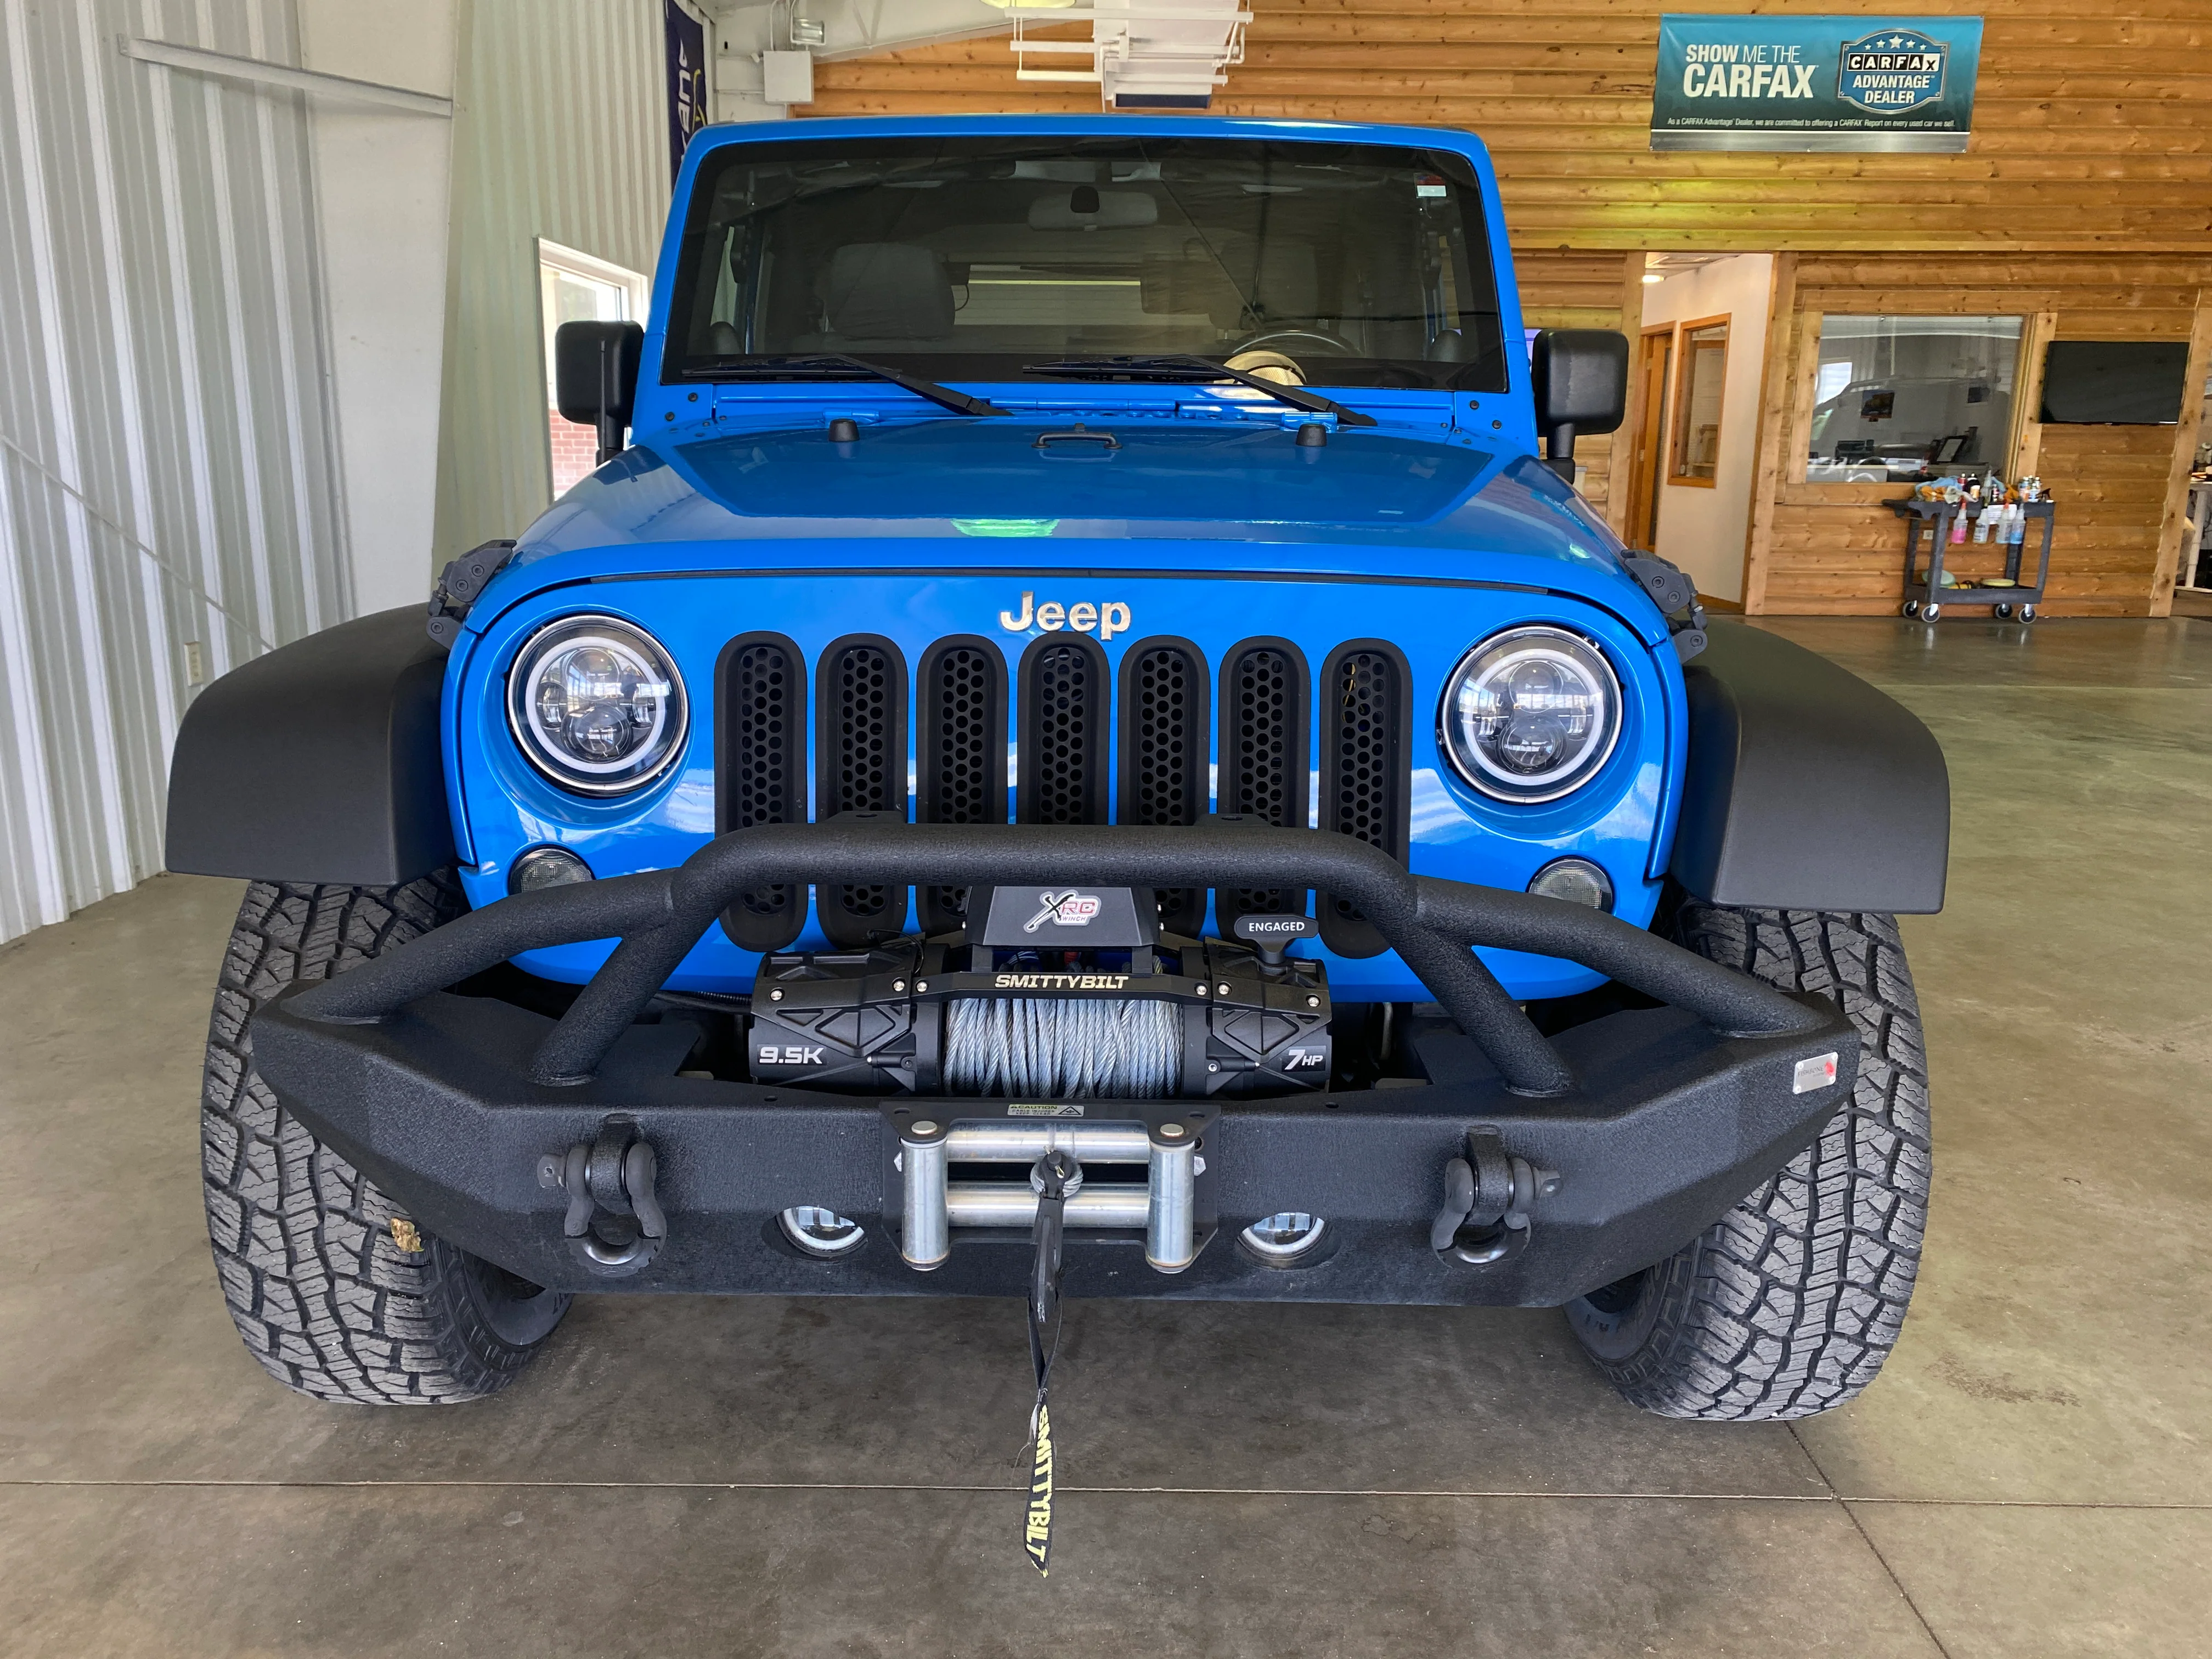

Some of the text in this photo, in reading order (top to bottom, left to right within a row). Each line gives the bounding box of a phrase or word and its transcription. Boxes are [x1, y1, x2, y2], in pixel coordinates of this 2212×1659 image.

[1686, 44, 1801, 63] SHOW ME THE
[1849, 54, 1937, 71] CARFAX
[1683, 64, 1815, 98] CARFAX
[1853, 75, 1930, 89] ADVANTAGE
[1864, 89, 1915, 104] DEALER
[1667, 117, 1675, 125] As
[1681, 117, 1703, 126] CARFAX
[1704, 117, 1733, 127] Advantage
[1735, 118, 1754, 126] Dealer,
[1775, 118, 1804, 126] committed
[1812, 119, 1833, 128] offering
[1839, 119, 1862, 127] CARFAX
[1864, 119, 1883, 128] Report
[1000, 590, 1131, 641] Jeep
[1027, 893, 1096, 929] XRC
[1248, 921, 1305, 933] ENGAGED
[994, 975, 1128, 990] SMITTYBILT
[759, 1046, 823, 1064] 9.5K
[1285, 1048, 1323, 1071] 7HP
[1026, 1404, 1053, 1563] SMITTYBILT
